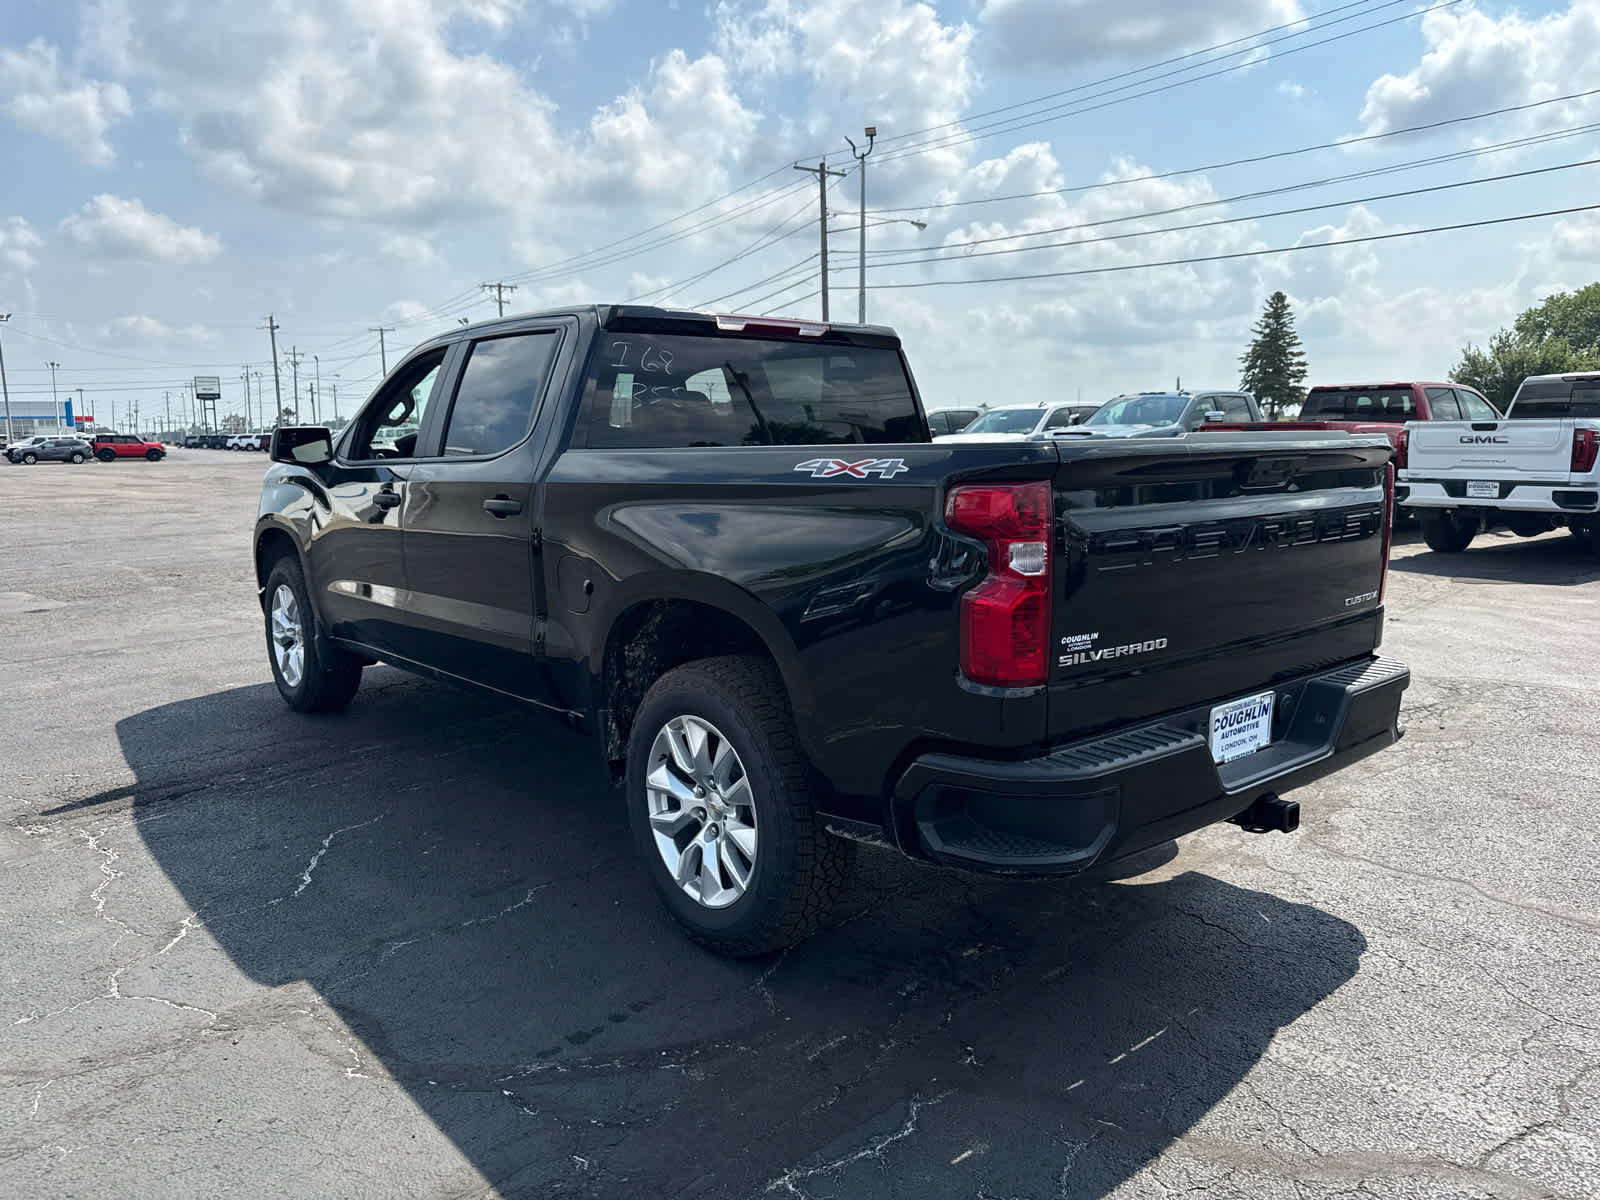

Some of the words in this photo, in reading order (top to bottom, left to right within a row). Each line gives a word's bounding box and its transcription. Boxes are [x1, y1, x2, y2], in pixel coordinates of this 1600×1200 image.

[1459, 435, 1510, 444] GMC
[1095, 510, 1382, 572] CHEVROLET
[1061, 632, 1099, 645] COUGHLIN
[1058, 637, 1168, 667] SILVERADO
[1213, 702, 1270, 733] COUGHLIN
[1220, 720, 1260, 740] AUTOMOTIVE
